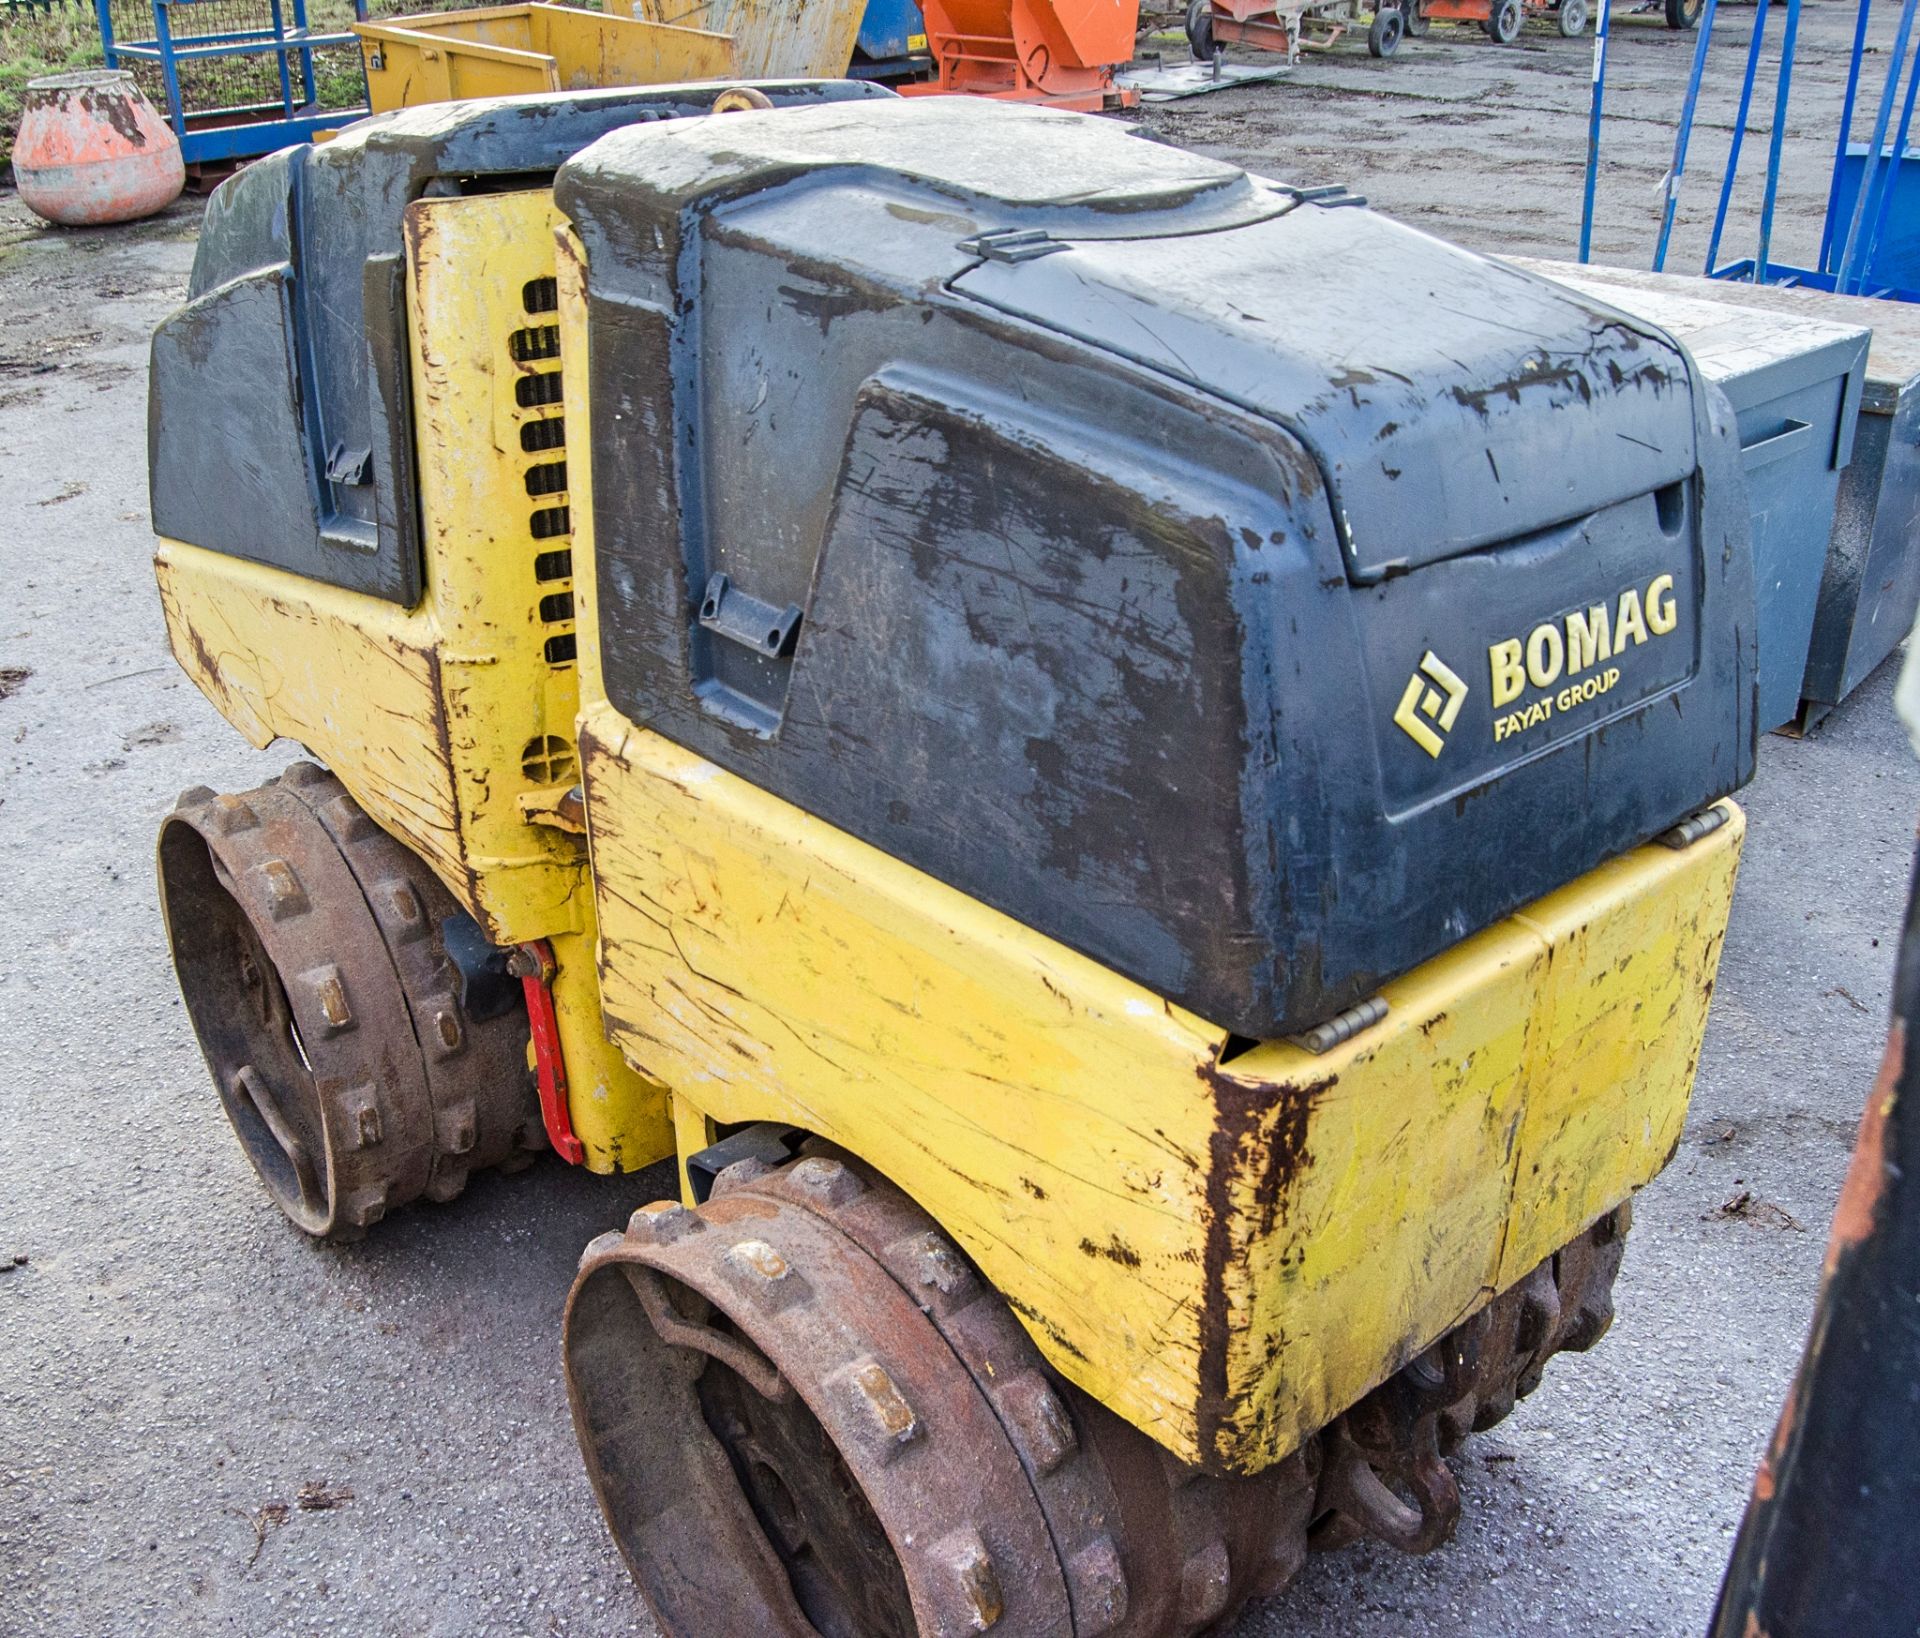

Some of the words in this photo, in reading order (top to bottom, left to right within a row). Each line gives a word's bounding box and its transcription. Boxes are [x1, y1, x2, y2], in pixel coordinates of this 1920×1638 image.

[1489, 574, 1677, 709] BOMAG
[1494, 697, 1553, 742] FAYAT
[1556, 668, 1620, 712] GROUP
